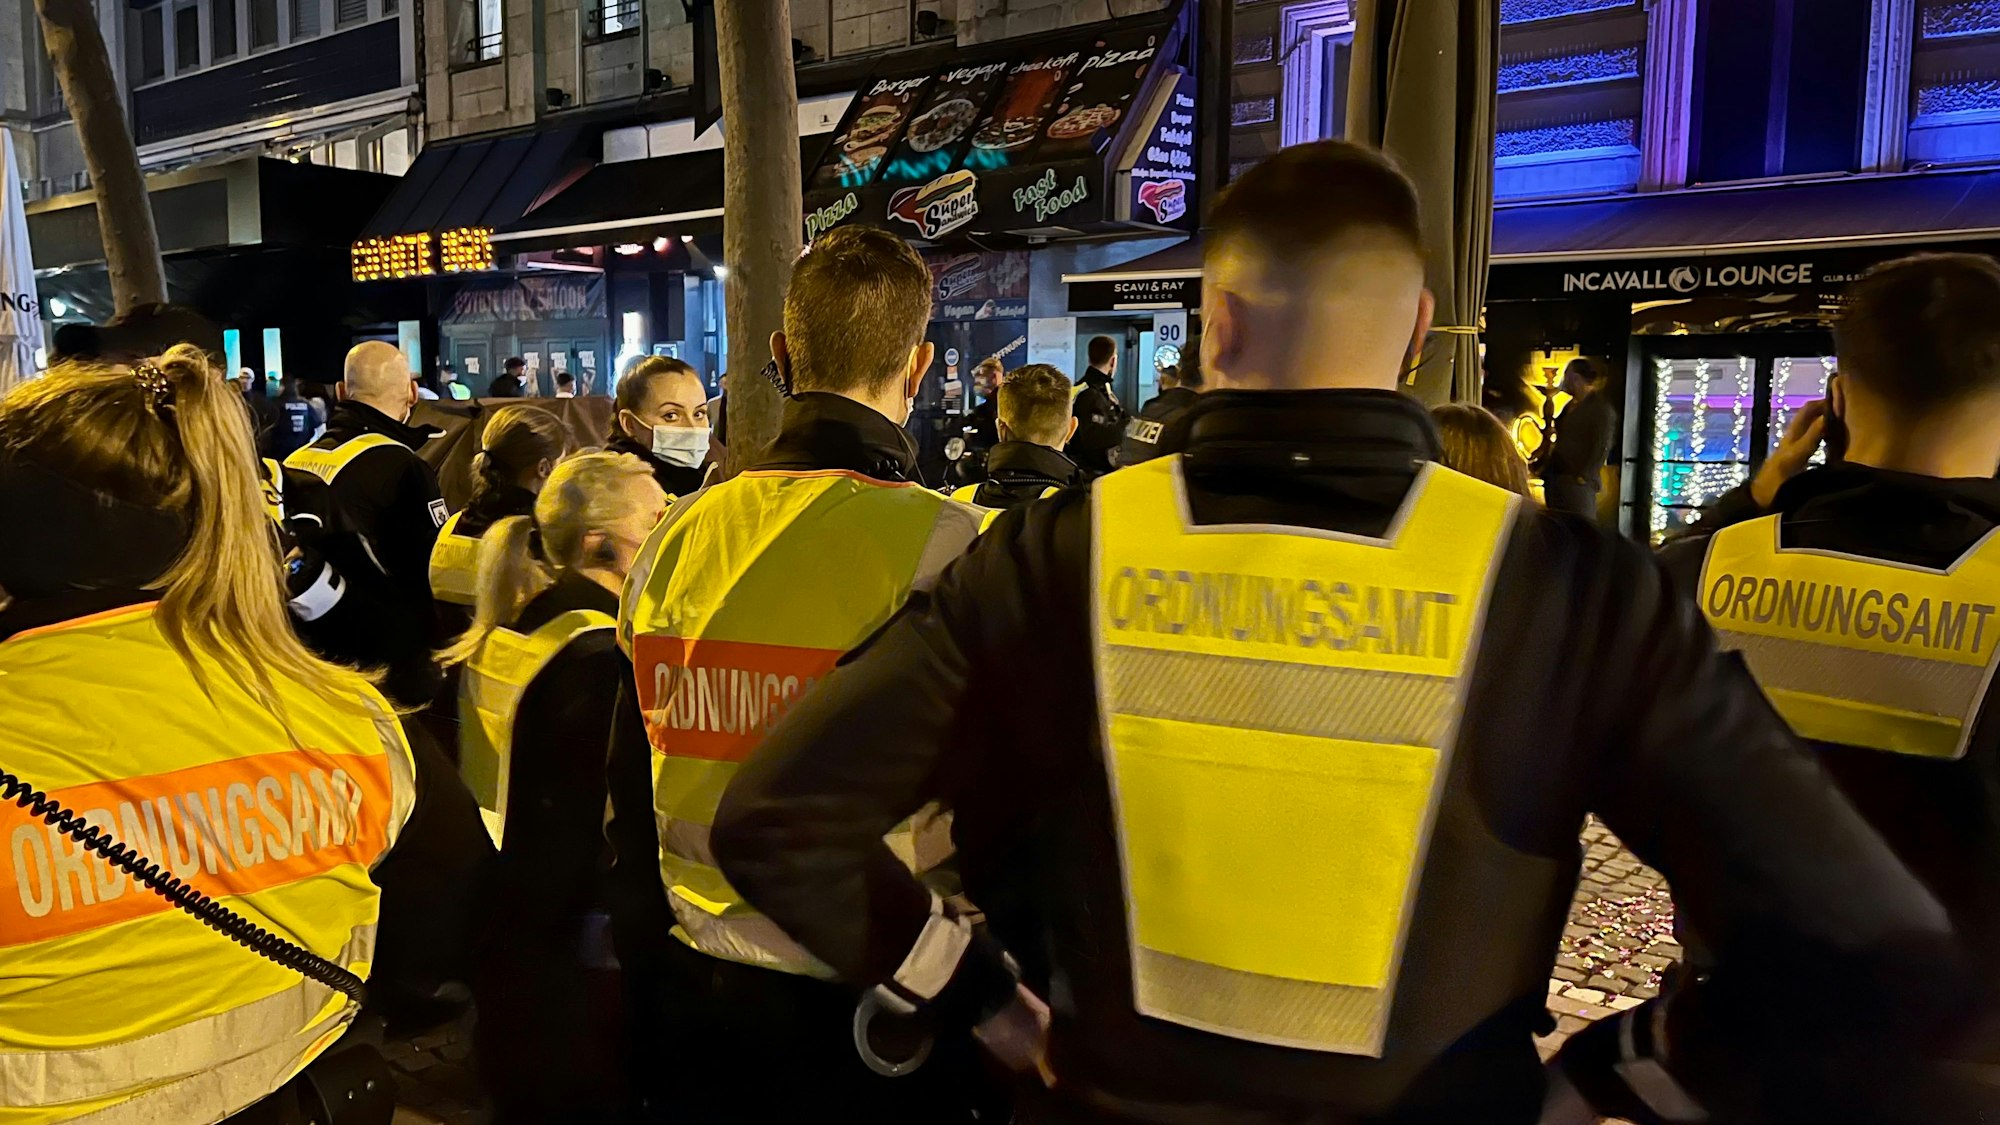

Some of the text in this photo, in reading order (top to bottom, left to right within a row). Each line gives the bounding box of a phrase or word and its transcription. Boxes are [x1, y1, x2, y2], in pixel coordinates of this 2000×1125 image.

[869, 76, 930, 96] Burger
[1013, 168, 1056, 212] Fast
[1034, 176, 1087, 222] Food
[804, 192, 858, 240] Pizza
[1563, 263, 1813, 292] INCAVALL LOUNGE
[1160, 324, 1180, 341] 90
[1109, 566, 1457, 660] ORDNUNGSAMT
[1708, 573, 1995, 653] ORDNUNGSAMT
